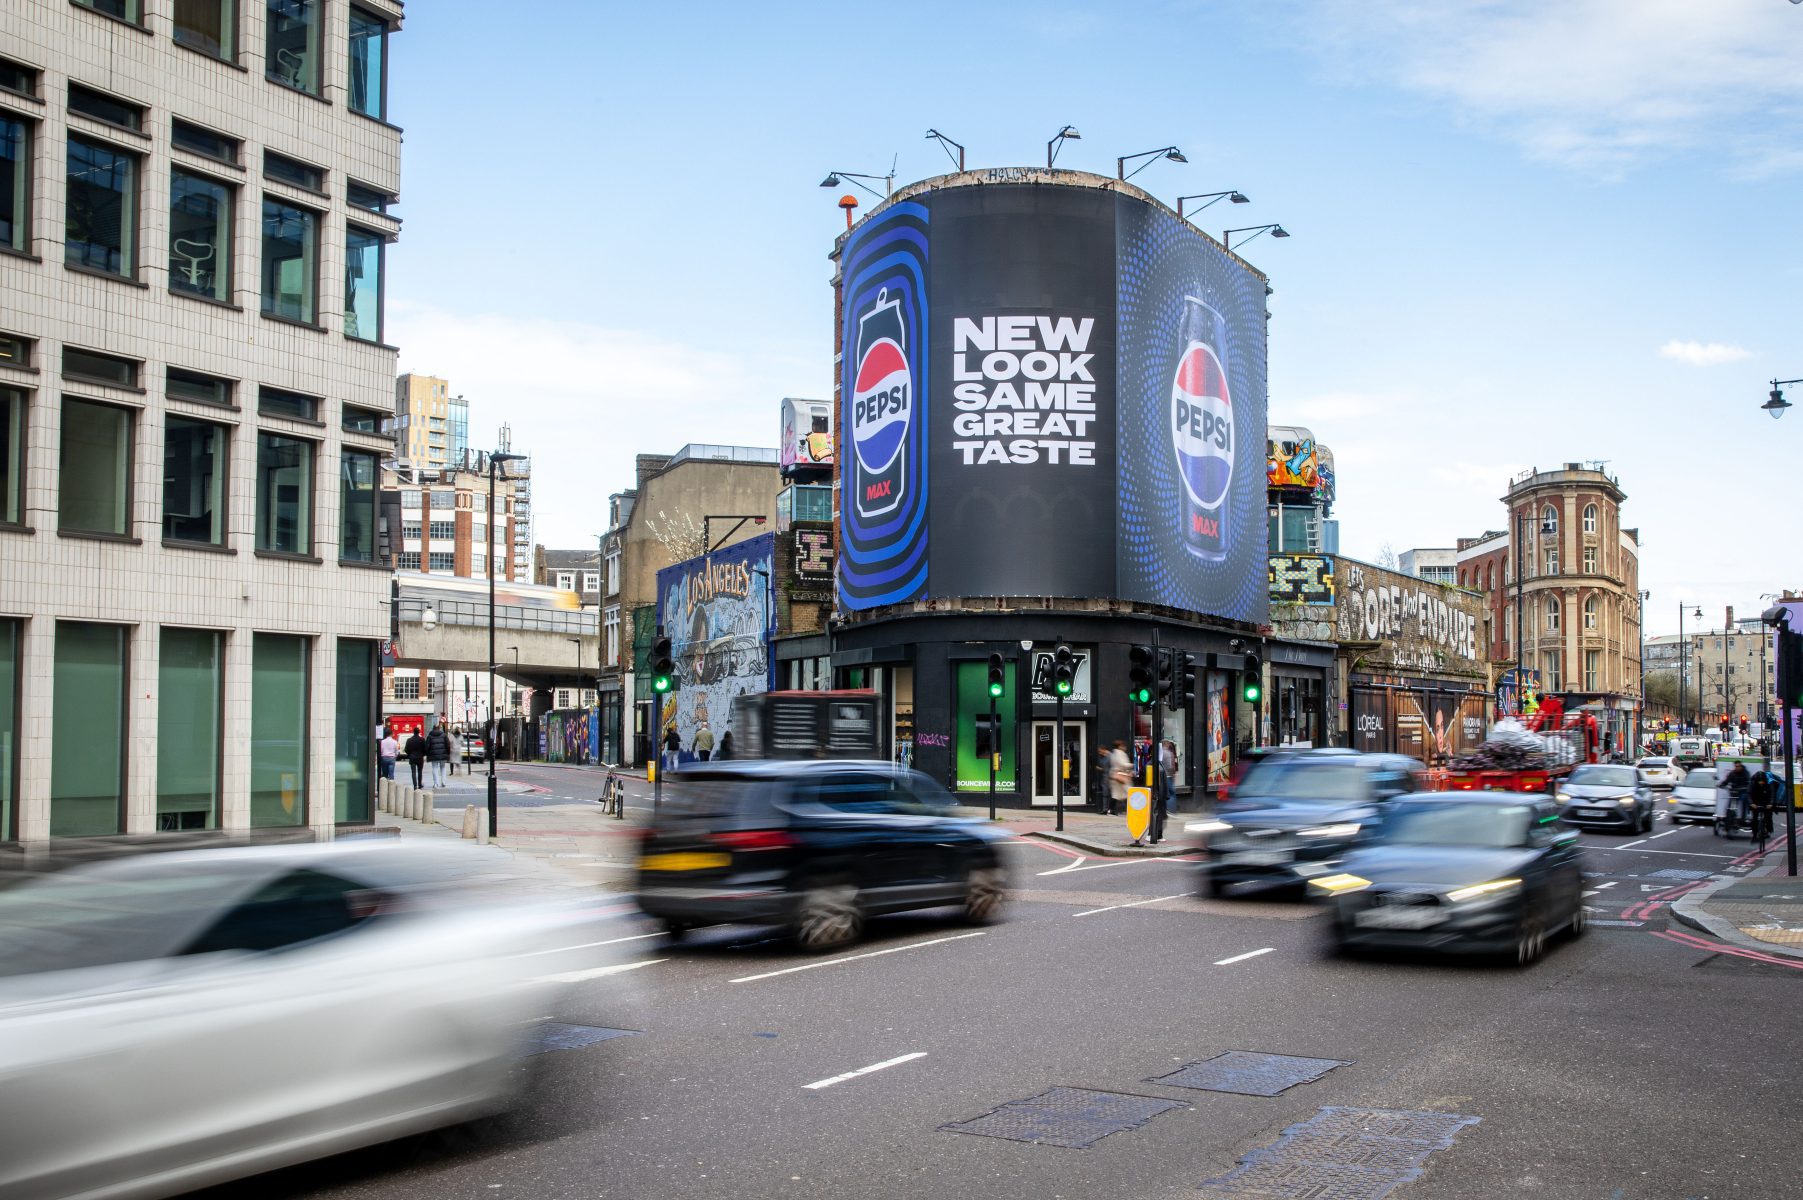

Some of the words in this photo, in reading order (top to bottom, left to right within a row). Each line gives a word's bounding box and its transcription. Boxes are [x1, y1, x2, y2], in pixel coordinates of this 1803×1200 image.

[953, 316, 1095, 352] NEW
[953, 352, 1096, 382] LOOK
[855, 382, 908, 429] PEPSI
[953, 382, 1096, 411] SAME
[953, 412, 1096, 437] GREAT
[1176, 398, 1231, 453] PEPSI
[953, 440, 1096, 466] TASTE
[866, 480, 892, 502] MAX
[1192, 511, 1219, 539] MAX
[1418, 591, 1476, 661] ENDURE
[385, 642, 391, 651] 20
[1357, 714, 1384, 732] L'ORÉAL
